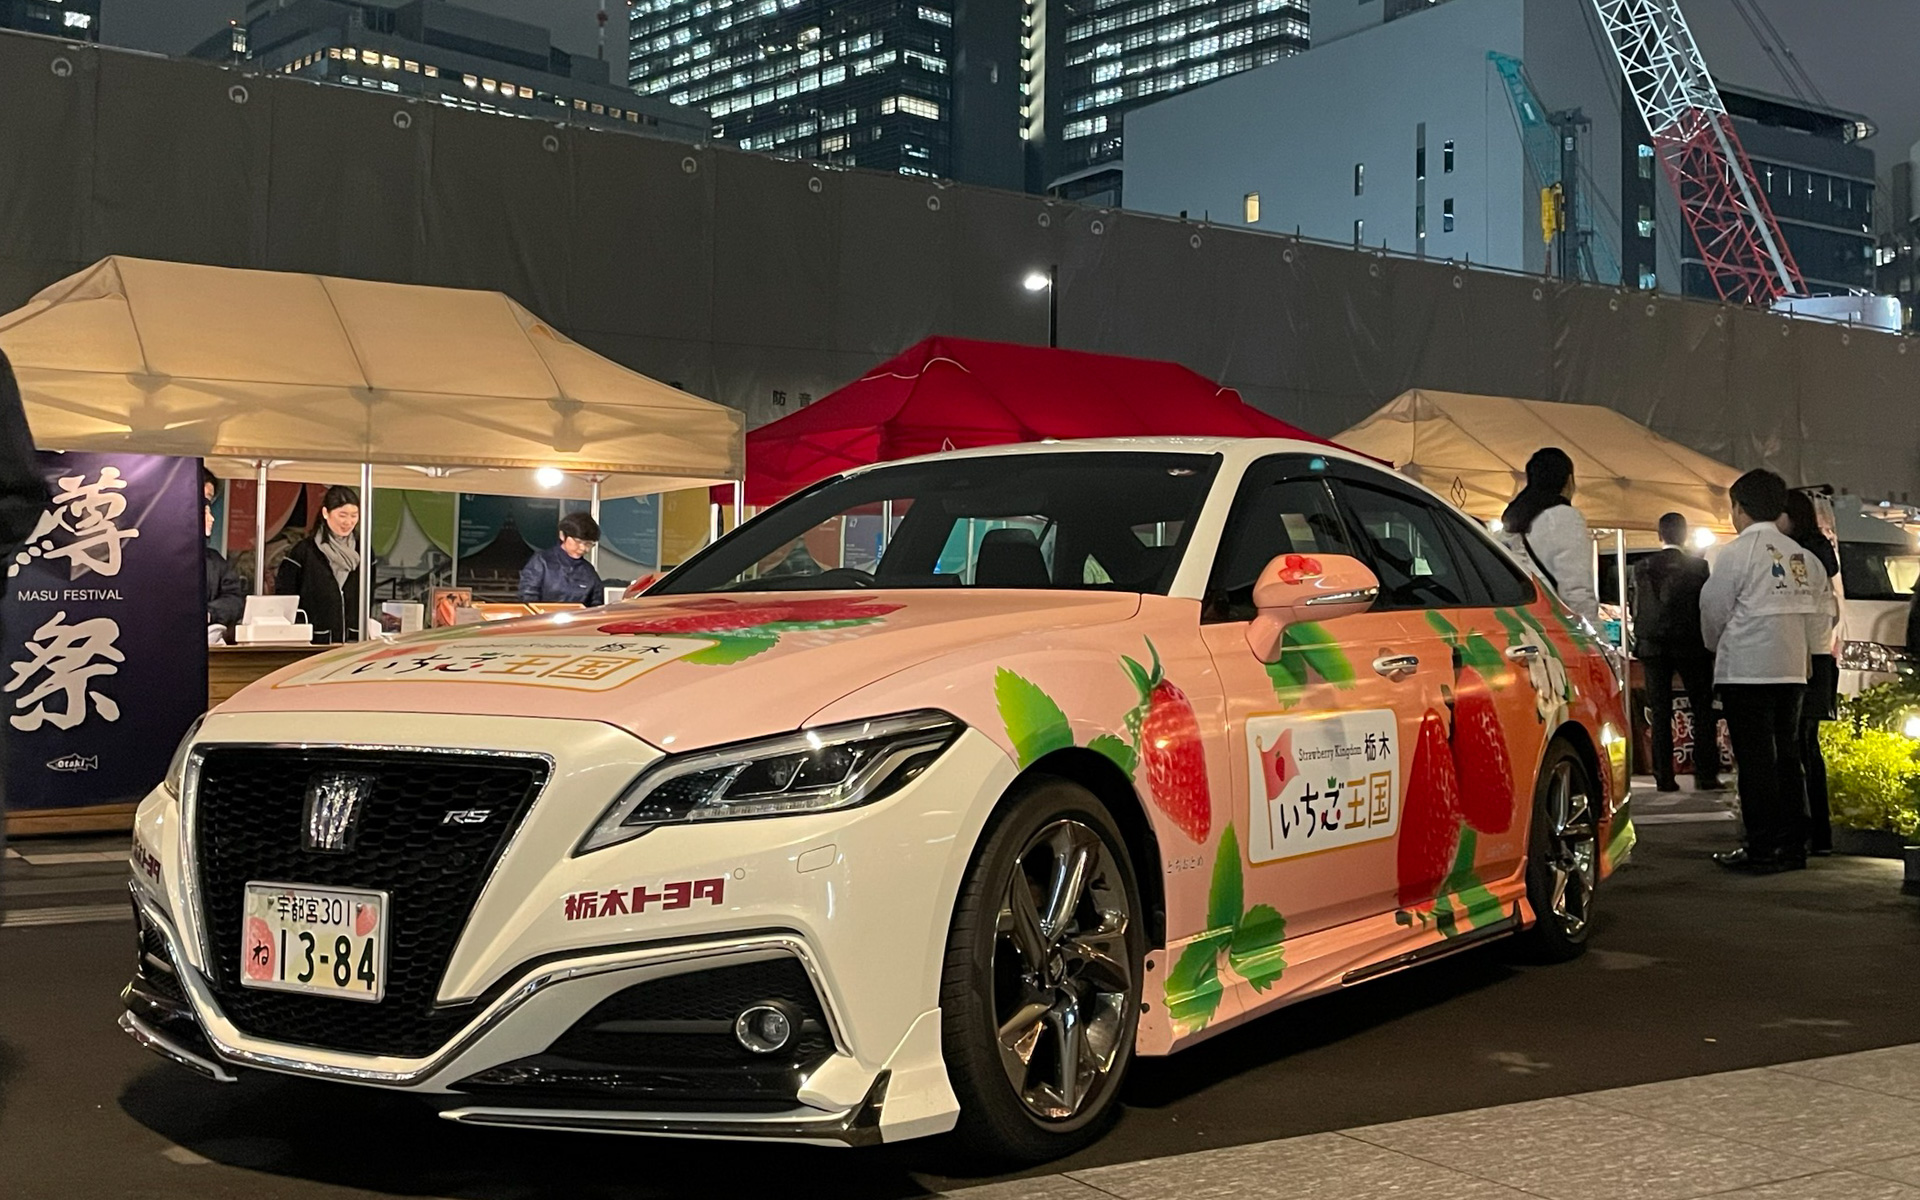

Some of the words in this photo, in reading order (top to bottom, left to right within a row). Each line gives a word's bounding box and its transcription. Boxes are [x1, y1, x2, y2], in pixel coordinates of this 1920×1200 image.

[18, 590, 58, 602] MASU
[63, 589, 123, 601] FESTIVAL
[3, 610, 126, 732] 祭
[351, 652, 644, 680] いちご王国
[1298, 746, 1334, 762] Strawberry
[1364, 731, 1391, 762] 栃木
[442, 810, 491, 824] RS
[1280, 769, 1392, 839] いちご王国
[564, 877, 725, 921] 栃木トヨタ
[252, 939, 270, 966] ね
[280, 928, 376, 991] 13-84
